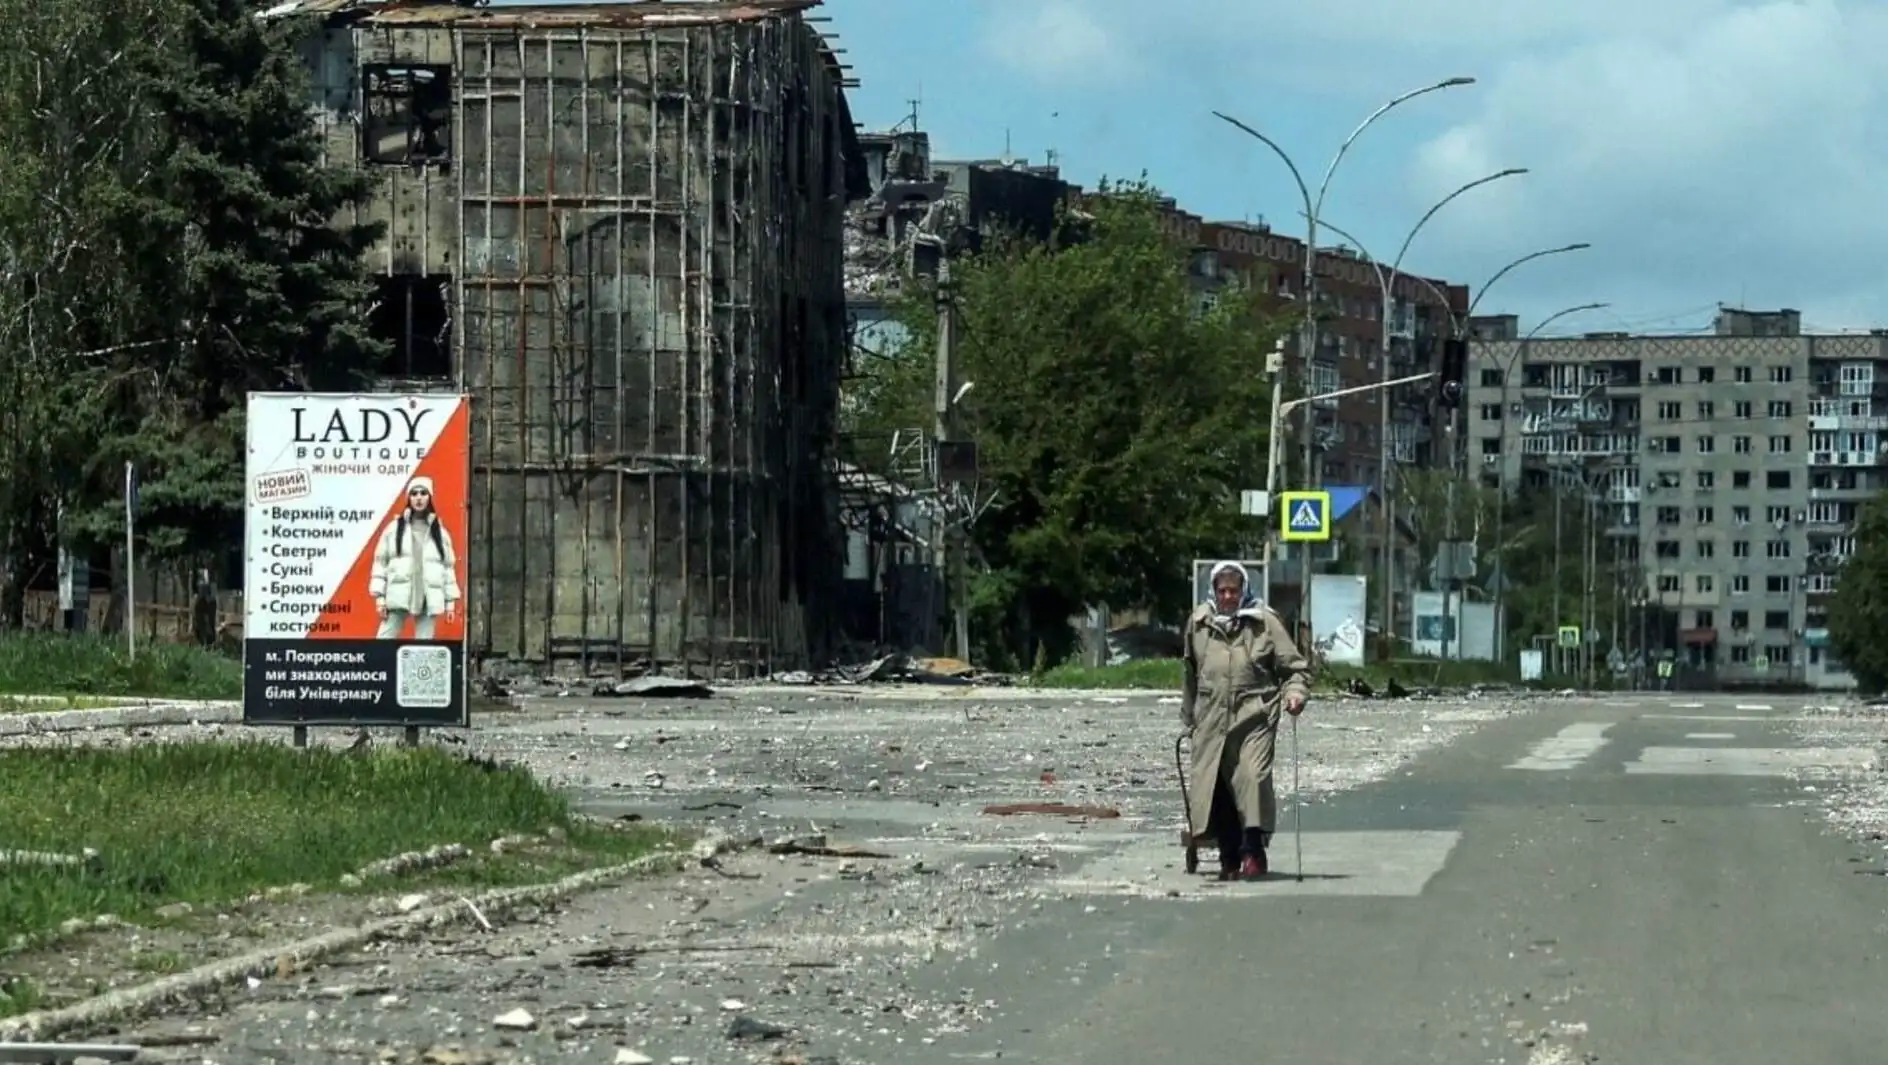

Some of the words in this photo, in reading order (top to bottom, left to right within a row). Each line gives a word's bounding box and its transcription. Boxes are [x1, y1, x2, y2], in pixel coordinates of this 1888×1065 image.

[291, 406, 434, 443] LADY
[296, 447, 426, 459] BOUTIQUE
[257, 471, 306, 489] НОВИЙ
[259, 485, 307, 499] МАГАЗИН
[271, 506, 335, 523] Верхній
[339, 509, 375, 523] одяг
[271, 524, 344, 538] Костюми
[271, 544, 327, 559] Светри
[270, 562, 313, 579] Сукні
[270, 582, 324, 597] Брюки
[269, 600, 352, 615] Спортивні
[269, 621, 341, 633] костюми
[265, 652, 282, 663] м.
[285, 650, 365, 665] Покровськ
[265, 670, 287, 681] ми
[289, 670, 388, 684] знаходимося
[265, 686, 296, 700] біля
[299, 686, 383, 704] Універмагу
